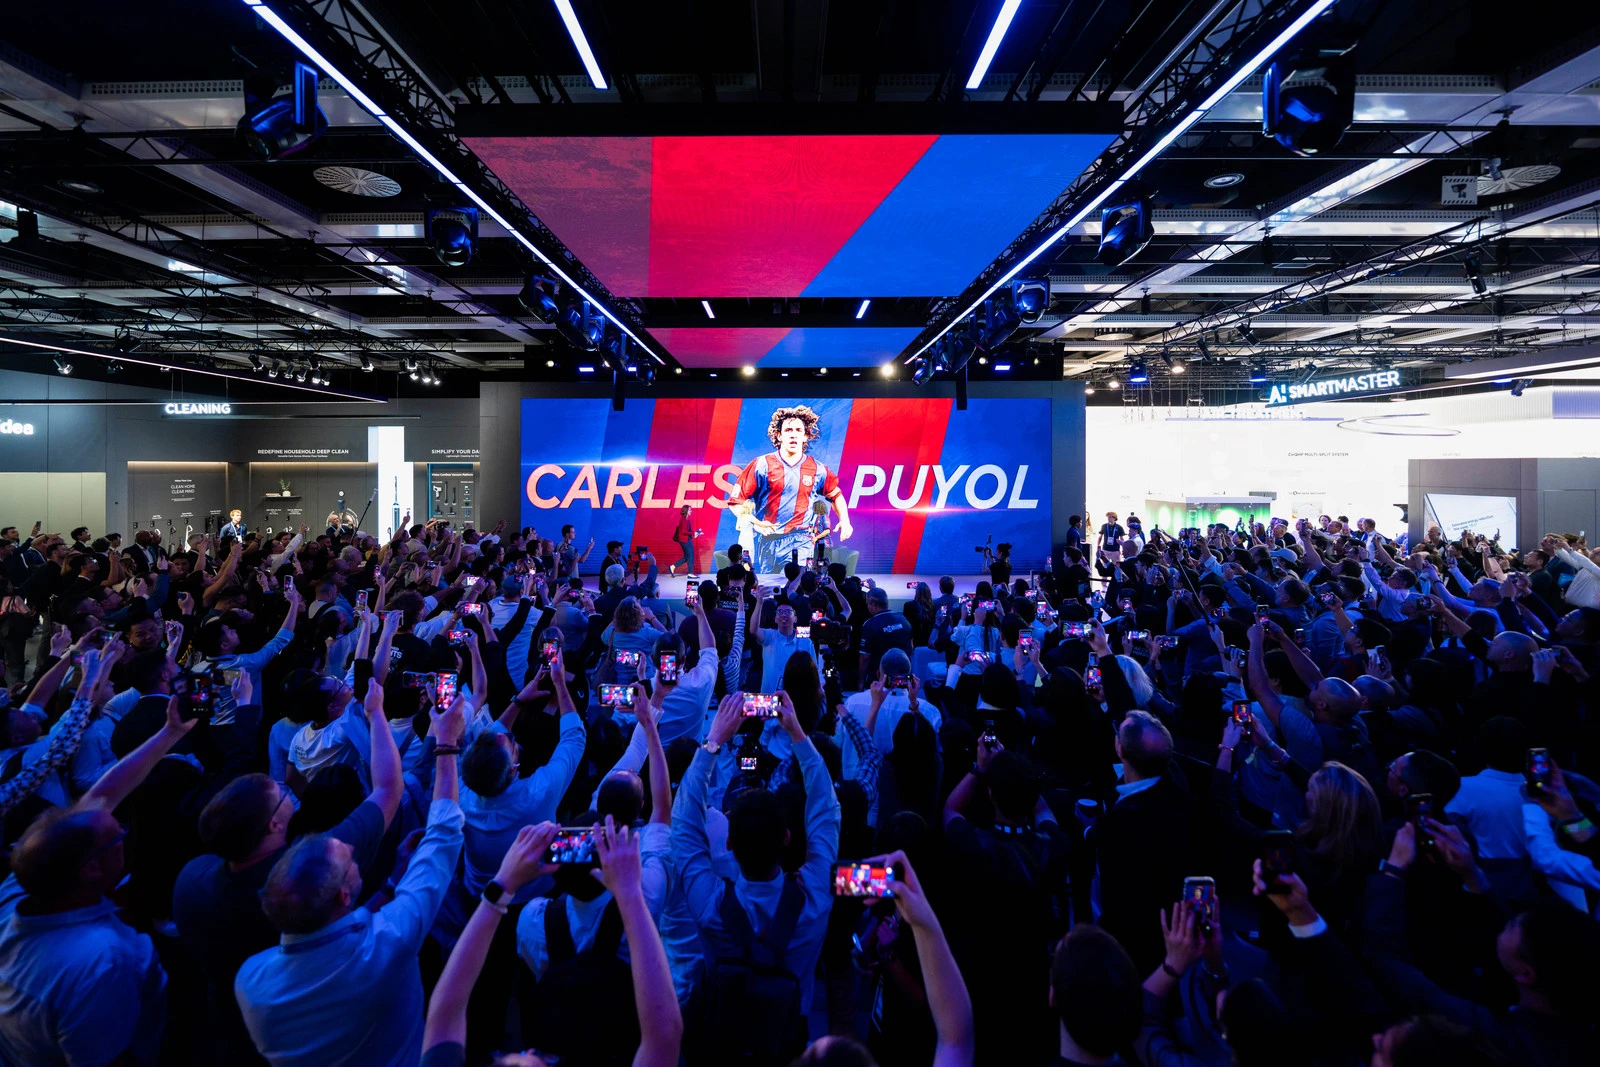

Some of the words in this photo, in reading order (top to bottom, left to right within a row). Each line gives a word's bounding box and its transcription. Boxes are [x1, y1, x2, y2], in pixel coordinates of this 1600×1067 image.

[1288, 370, 1400, 399] SMARTMASTER
[164, 403, 232, 415] CLEANING
[0, 418, 34, 435] dea
[526, 464, 743, 509] CARLES
[848, 464, 1039, 510] PUYOL
